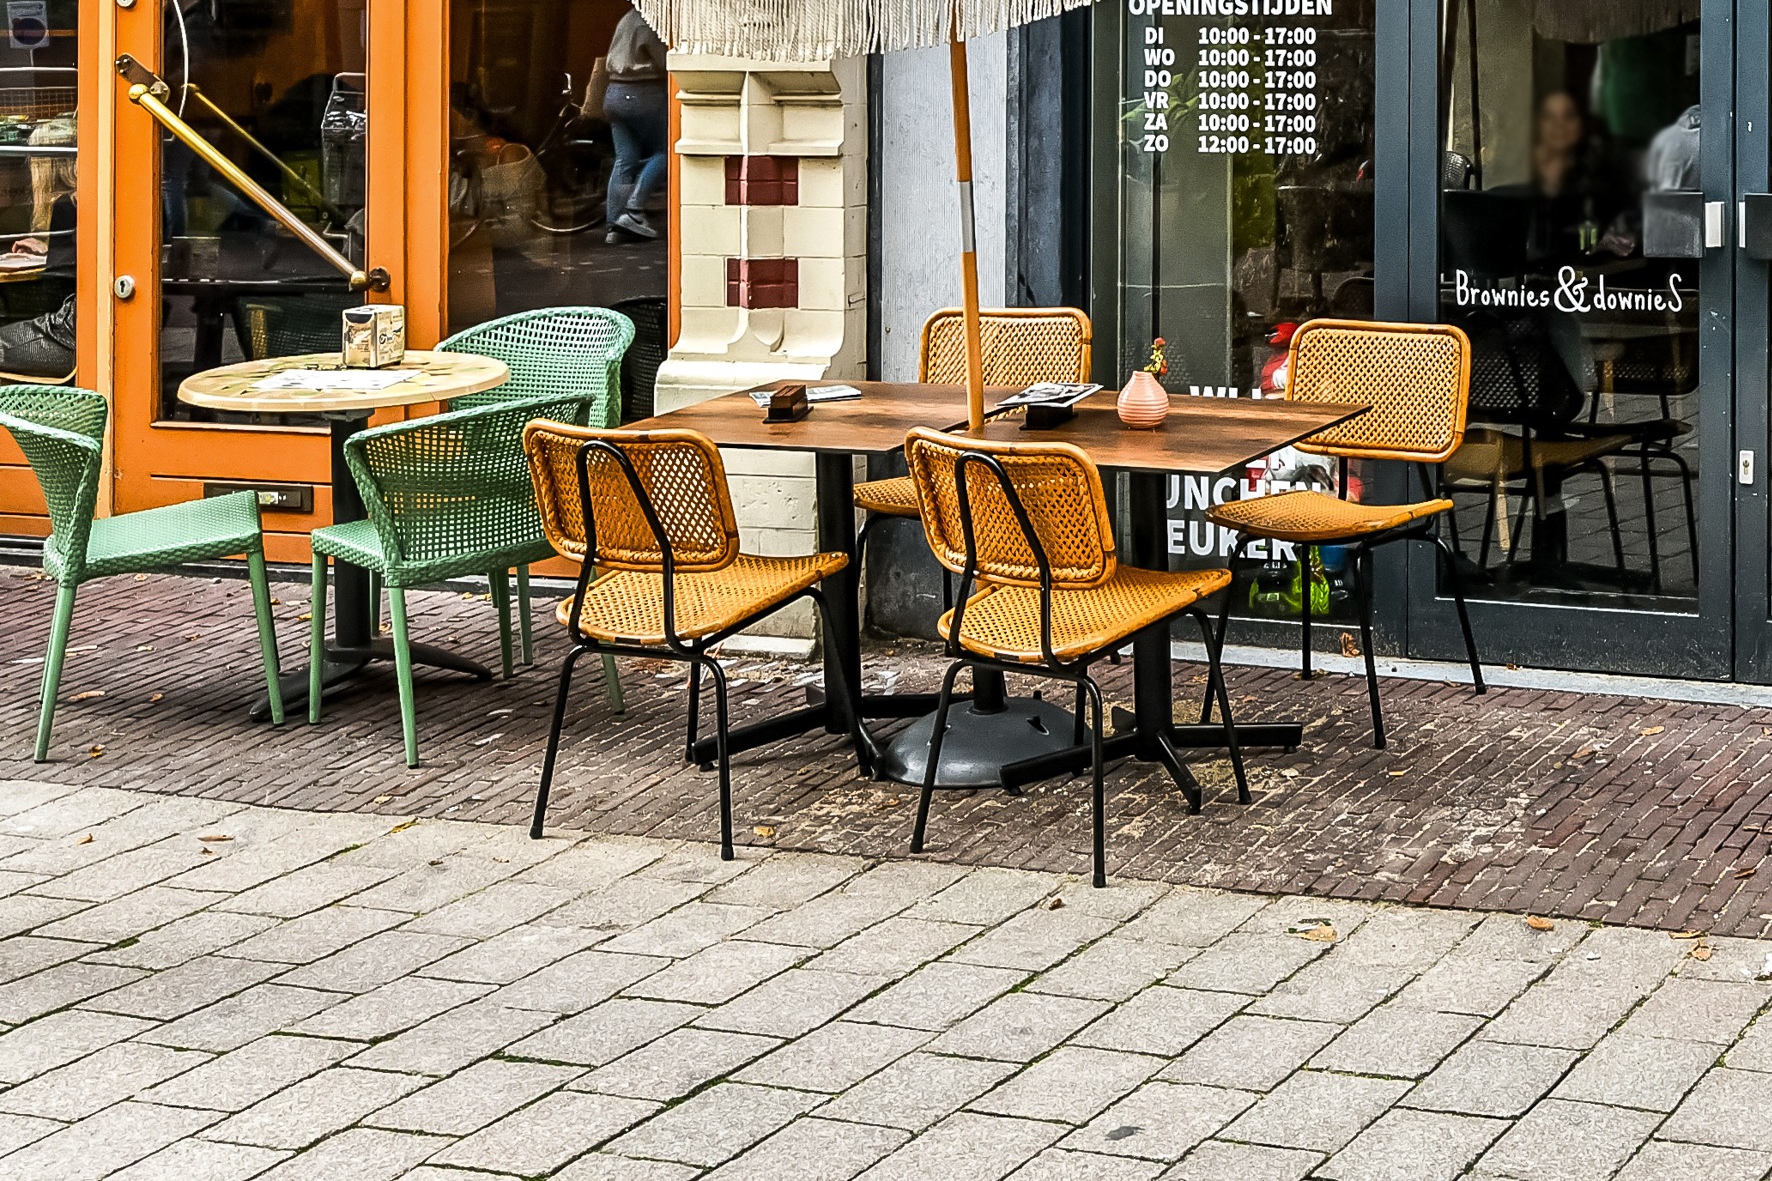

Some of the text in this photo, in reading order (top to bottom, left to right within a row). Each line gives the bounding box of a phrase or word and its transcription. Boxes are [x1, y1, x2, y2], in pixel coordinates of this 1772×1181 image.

[1145, 27, 1164, 45] DI
[1198, 27, 1249, 45] 10:00
[1264, 27, 1317, 45] 17:00
[1143, 48, 1175, 66] WO
[1198, 49, 1249, 67] 10:00
[1264, 49, 1317, 67] 17:00
[1144, 70, 1172, 88] DO
[1198, 70, 1249, 89] 10:00
[1264, 70, 1317, 89] 17:00
[1143, 91, 1169, 109] VR
[1198, 92, 1249, 110] 10:00
[1264, 92, 1317, 110] 17:00
[1143, 113, 1168, 131] ZA
[1198, 114, 1249, 132] 10:00
[1264, 114, 1317, 132] 17:00
[1143, 135, 1169, 152] ZO
[1198, 135, 1249, 154] 12:00
[1264, 135, 1317, 154] 17:00
[1456, 265, 1682, 312] Brownies & downieS
[1167, 519, 1297, 561] EUKER
